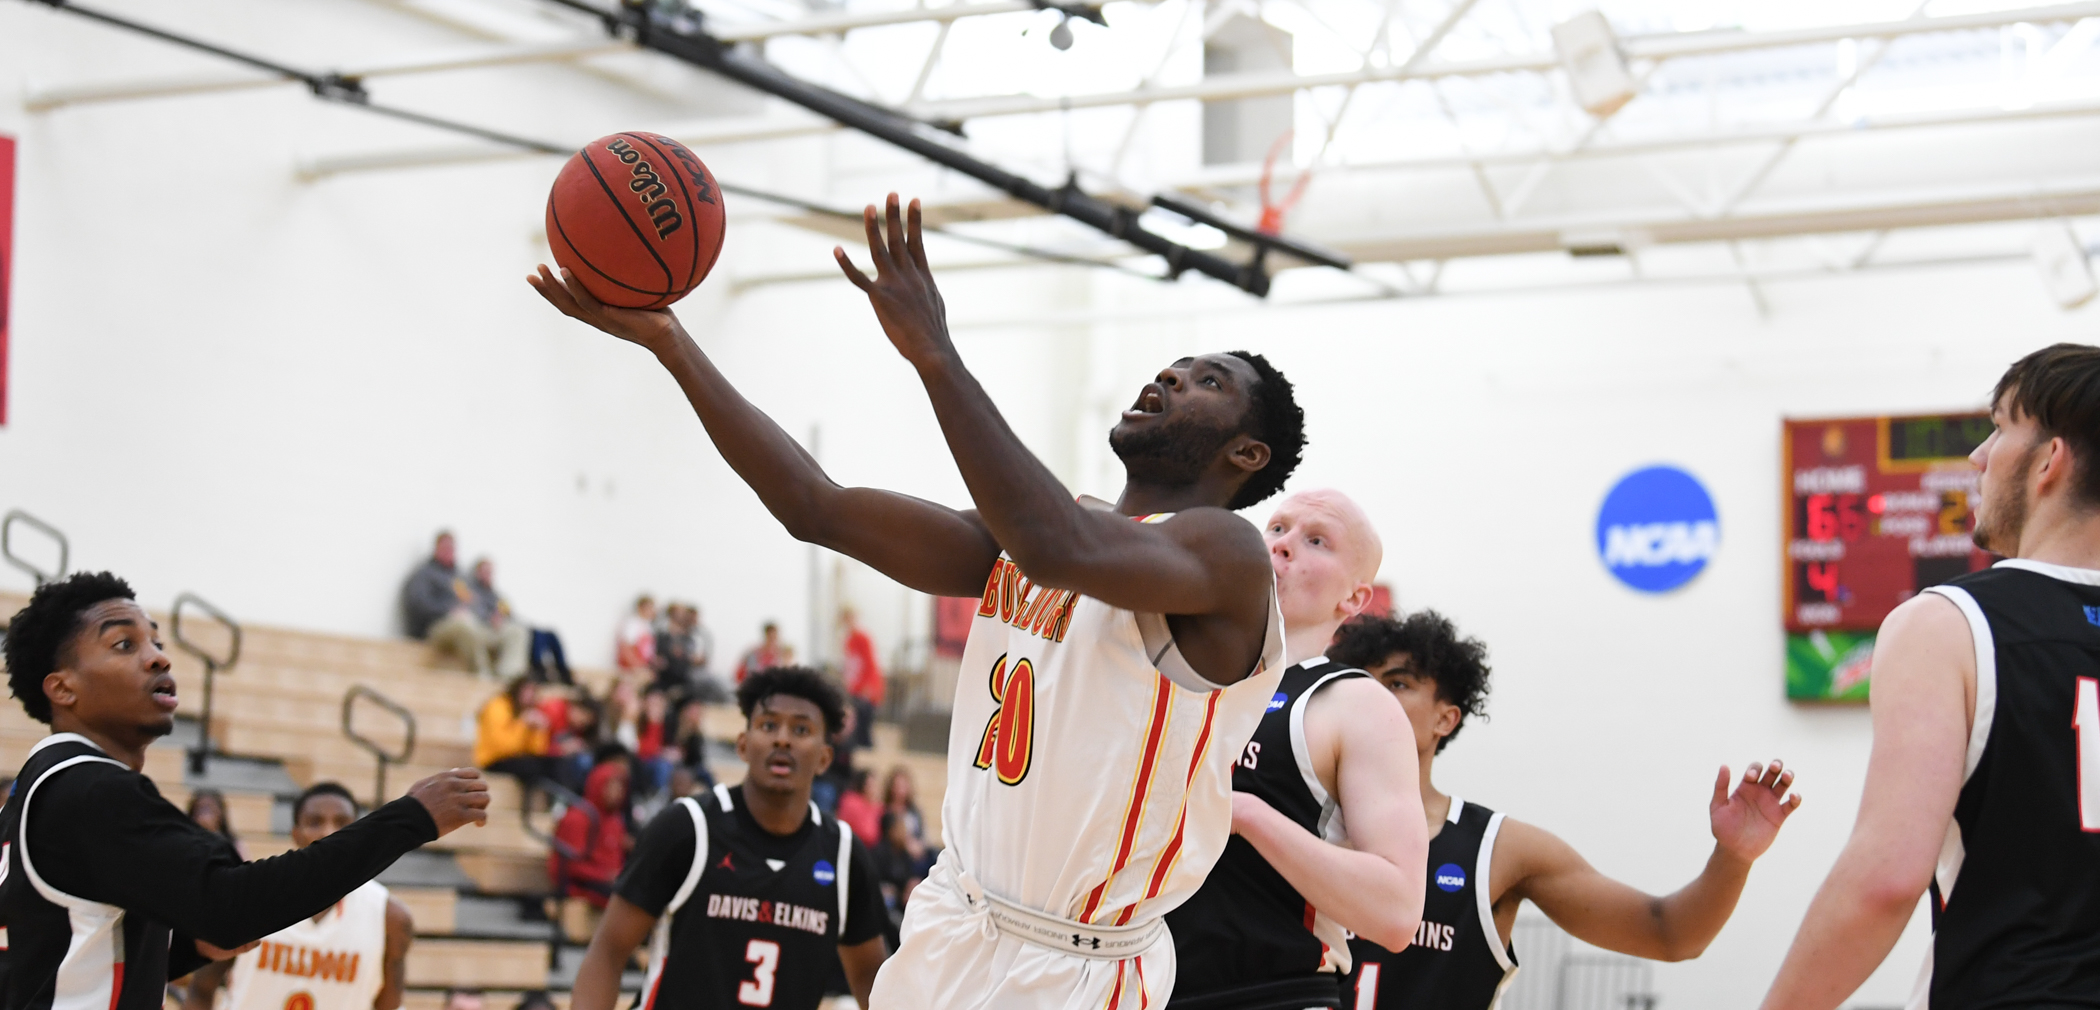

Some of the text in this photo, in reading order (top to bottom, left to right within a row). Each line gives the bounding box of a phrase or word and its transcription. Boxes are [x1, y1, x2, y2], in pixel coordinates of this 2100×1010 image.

[606, 139, 683, 242] Wilson
[656, 137, 715, 205] NCAA
[1796, 468, 1866, 493] HOME
[1605, 519, 1719, 568] NCAA
[1807, 561, 1838, 602] 4
[1437, 875, 1465, 887] NCAA
[738, 938, 782, 1007] 3
